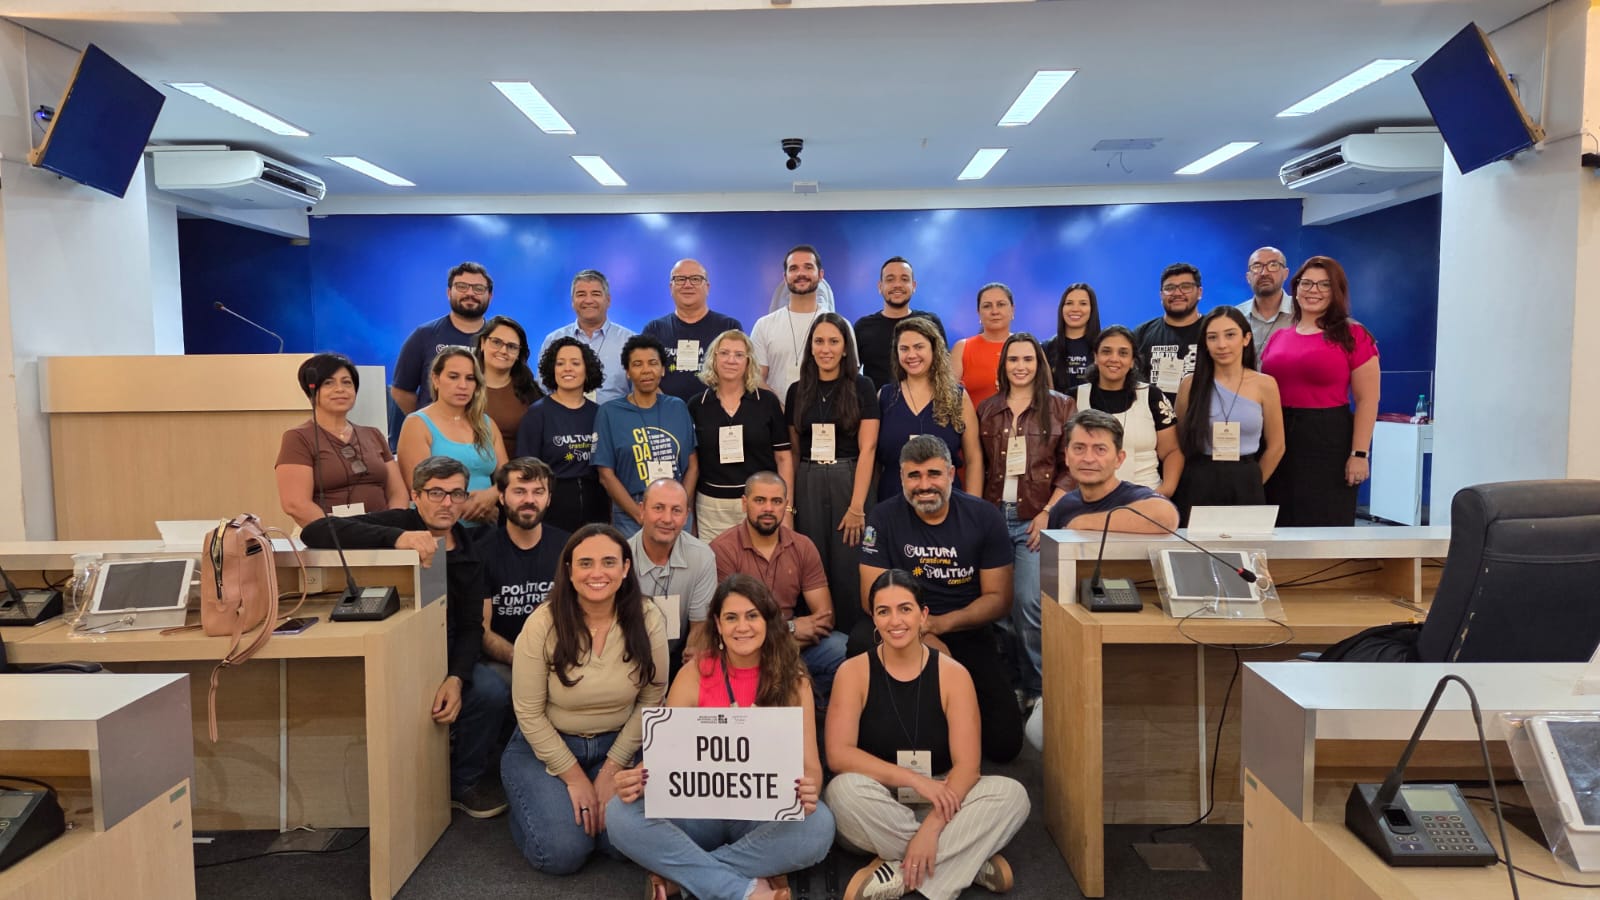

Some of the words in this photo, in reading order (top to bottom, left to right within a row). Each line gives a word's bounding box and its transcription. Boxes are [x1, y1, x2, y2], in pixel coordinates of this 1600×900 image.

[632, 427, 649, 444] CI
[632, 442, 653, 463] DA
[903, 543, 958, 558] CULTURA
[501, 581, 555, 596] POLÍTICA
[492, 593, 501, 604] É
[504, 596, 524, 606] UM
[696, 736, 750, 763] POLO
[669, 771, 779, 799] SUDOESTE
